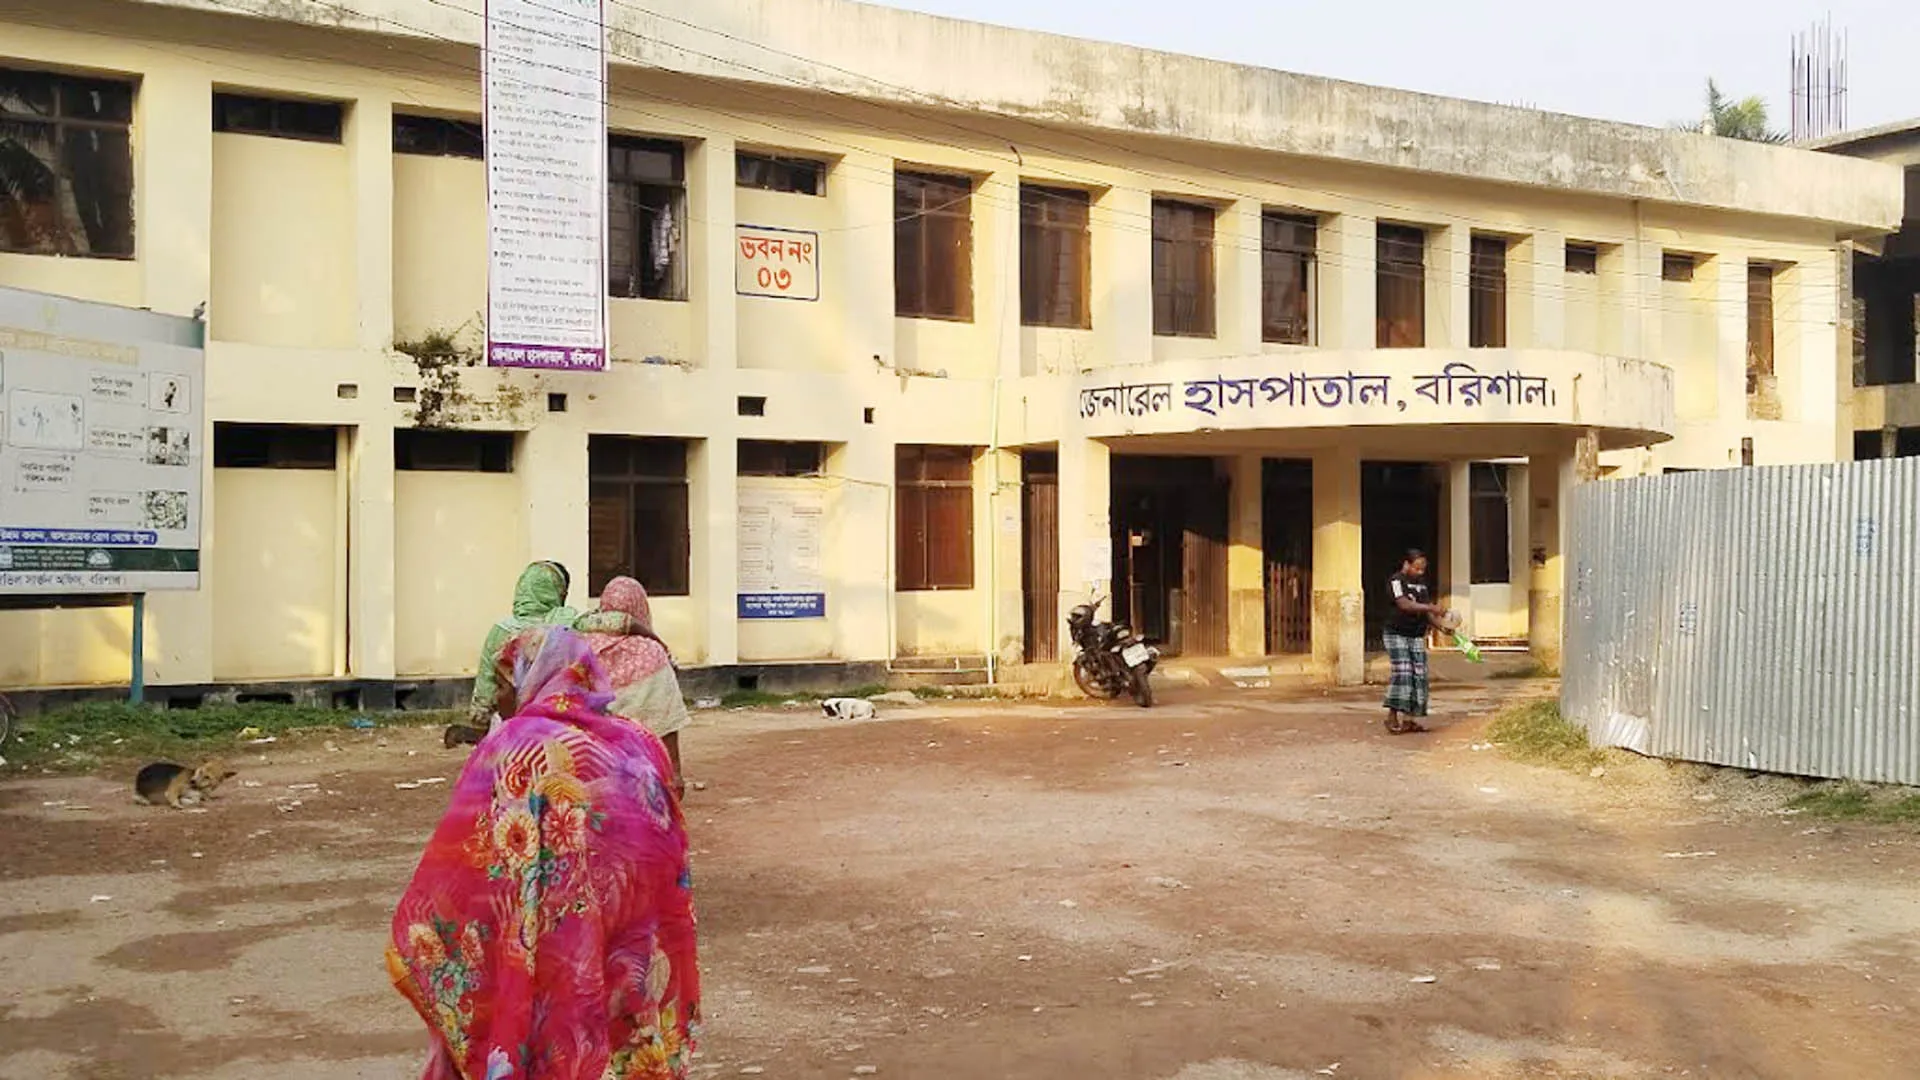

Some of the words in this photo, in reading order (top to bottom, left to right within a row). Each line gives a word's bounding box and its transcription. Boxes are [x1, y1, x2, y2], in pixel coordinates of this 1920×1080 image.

[740, 236, 784, 261] ভবন
[788, 241, 812, 264] নং
[757, 266, 792, 290] ০৩
[1079, 382, 1173, 419] জেনারেল
[1184, 369, 1407, 416] হাসপাতাল,
[1413, 362, 1556, 407] বরিশাল।
